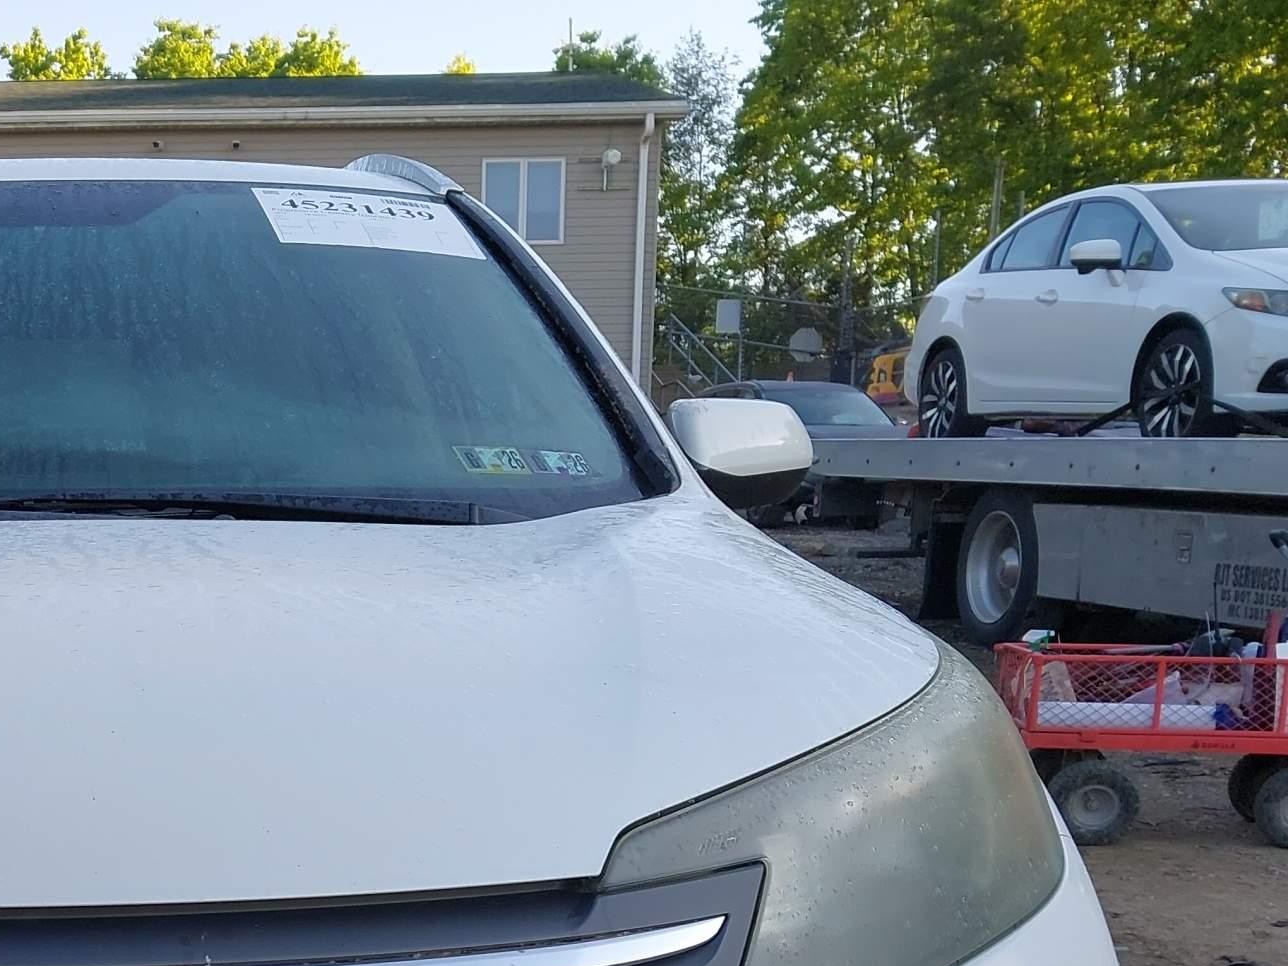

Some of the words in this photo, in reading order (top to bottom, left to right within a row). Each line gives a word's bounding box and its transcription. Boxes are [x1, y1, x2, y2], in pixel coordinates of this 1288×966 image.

[280, 198, 436, 221] 45231439
[501, 450, 526, 470] 26
[1232, 564, 1281, 592] SERVICES
